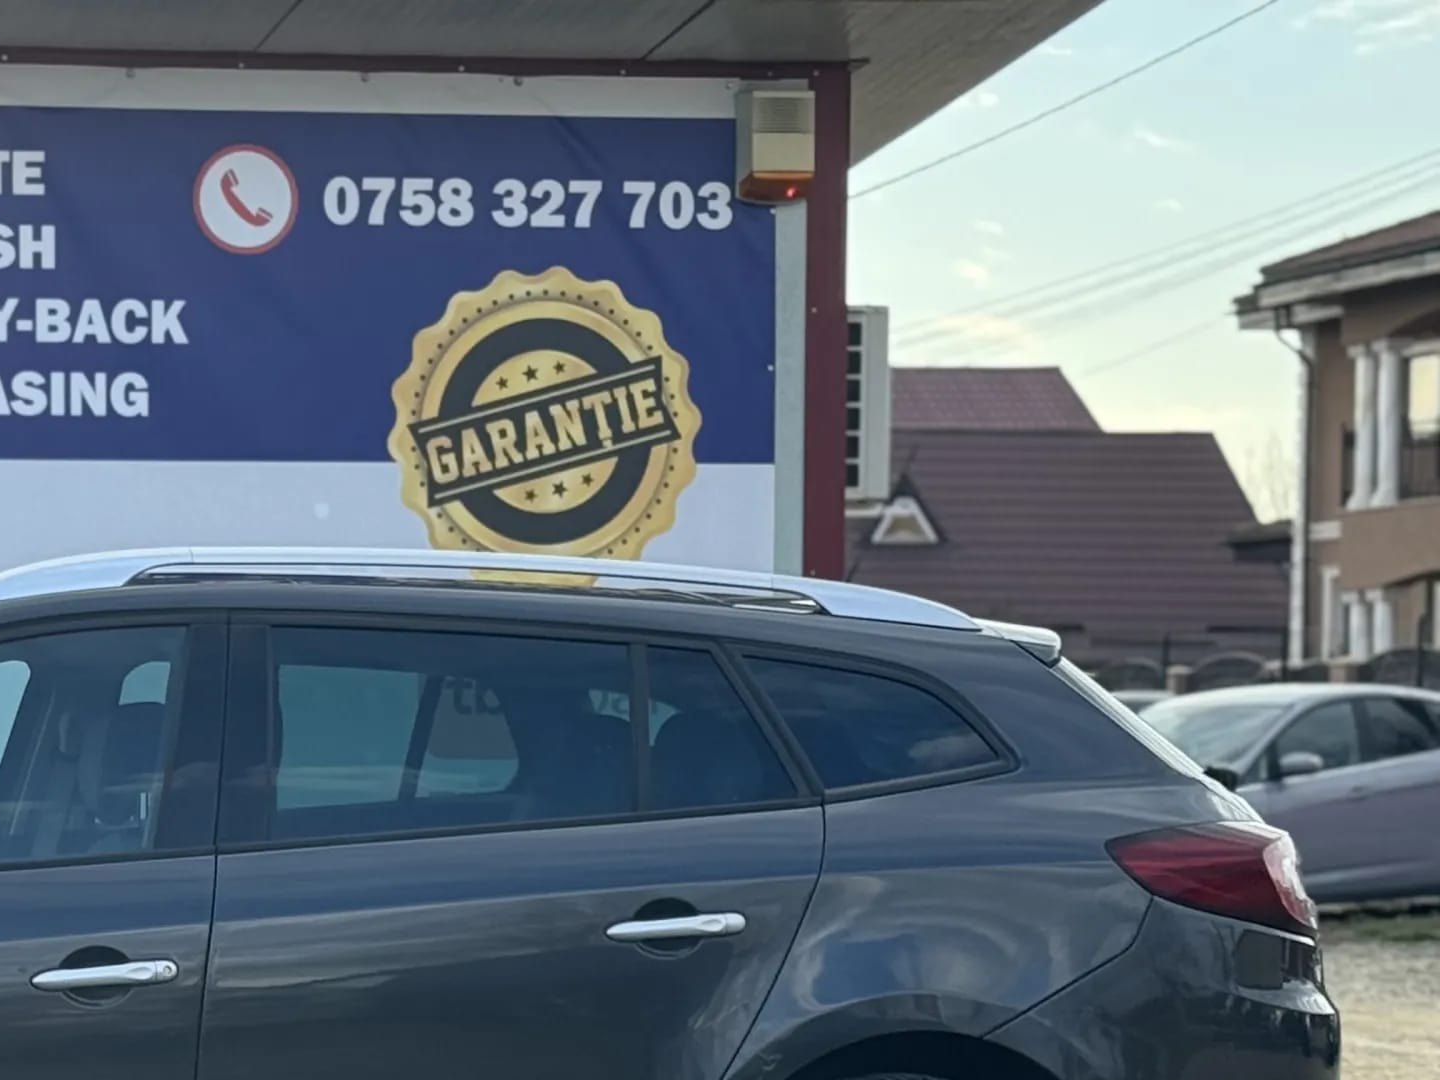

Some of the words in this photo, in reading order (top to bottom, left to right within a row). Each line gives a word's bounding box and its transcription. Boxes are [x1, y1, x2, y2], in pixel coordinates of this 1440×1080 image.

[323, 175, 474, 228] 0758
[492, 178, 603, 230] 327
[624, 181, 734, 232] 703
[425, 377, 665, 485] GARANȚIE
